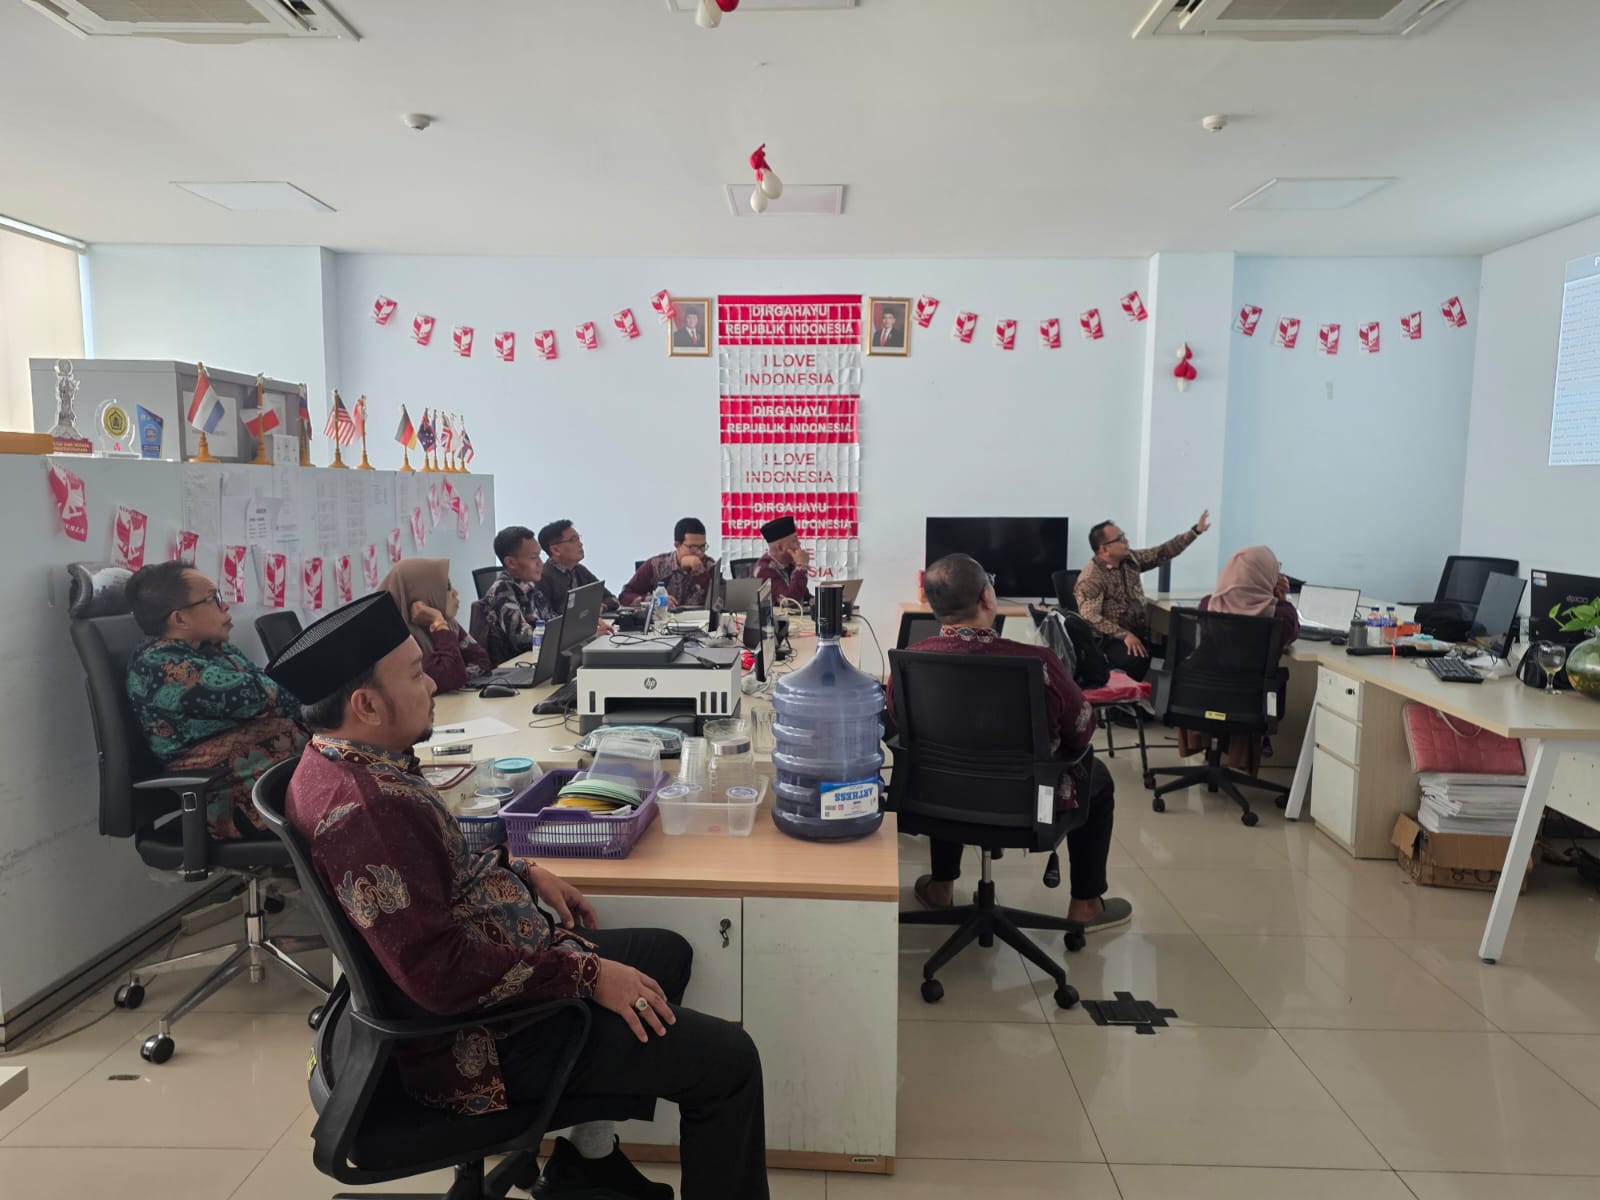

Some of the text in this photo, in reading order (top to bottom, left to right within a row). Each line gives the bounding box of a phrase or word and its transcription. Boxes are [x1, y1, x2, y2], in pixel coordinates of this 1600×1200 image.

[751, 305, 828, 317] DIRGAHAYU
[726, 323, 853, 334] REPUBLIK INDONESIA
[763, 354, 816, 367] I LOVE
[744, 373, 834, 386] INDONESIA
[752, 405, 828, 417] DIRGAHAYU
[727, 422, 851, 433] REPUBLIK INDONESIA
[764, 453, 816, 465] I LOVE
[746, 471, 834, 483] INDONESIA
[754, 502, 828, 513] DIRGAHAYU
[795, 519, 853, 530] NDONESIA
[644, 677, 657, 690] hp
